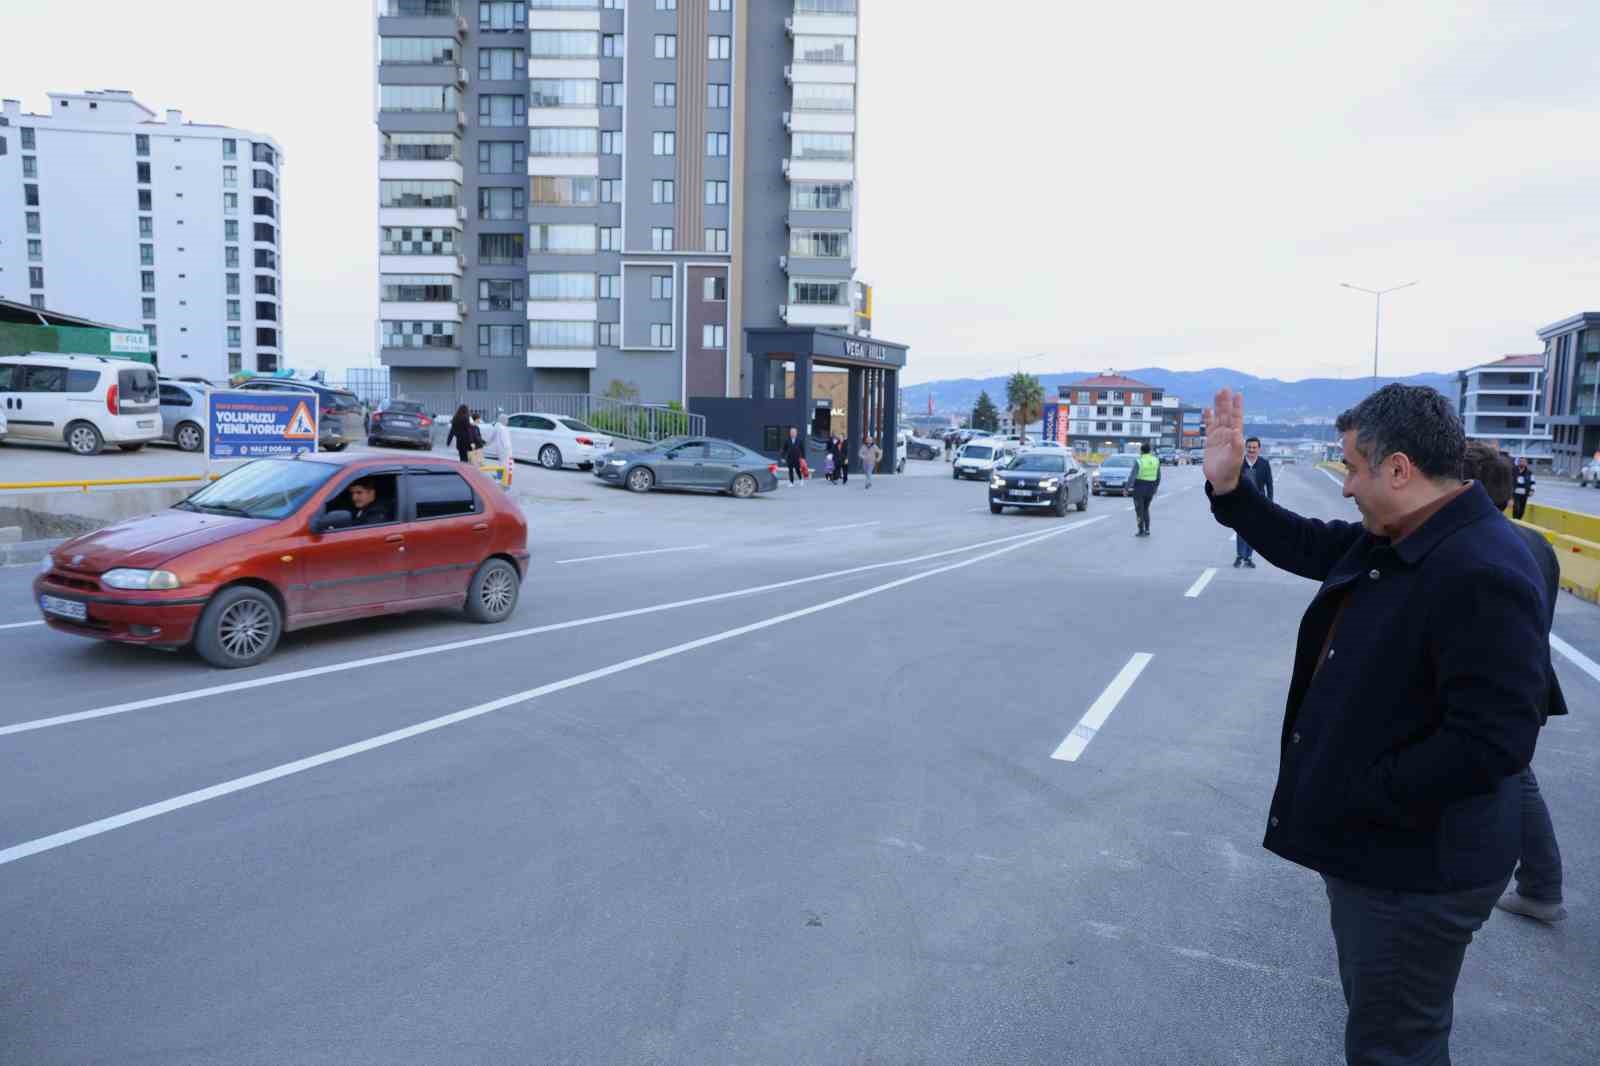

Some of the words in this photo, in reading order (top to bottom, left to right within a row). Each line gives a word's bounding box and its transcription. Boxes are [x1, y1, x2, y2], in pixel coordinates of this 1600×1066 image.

[846, 340, 863, 355] VEGA
[868, 343, 886, 360] HILLS
[216, 411, 276, 423] YOLUMUZU
